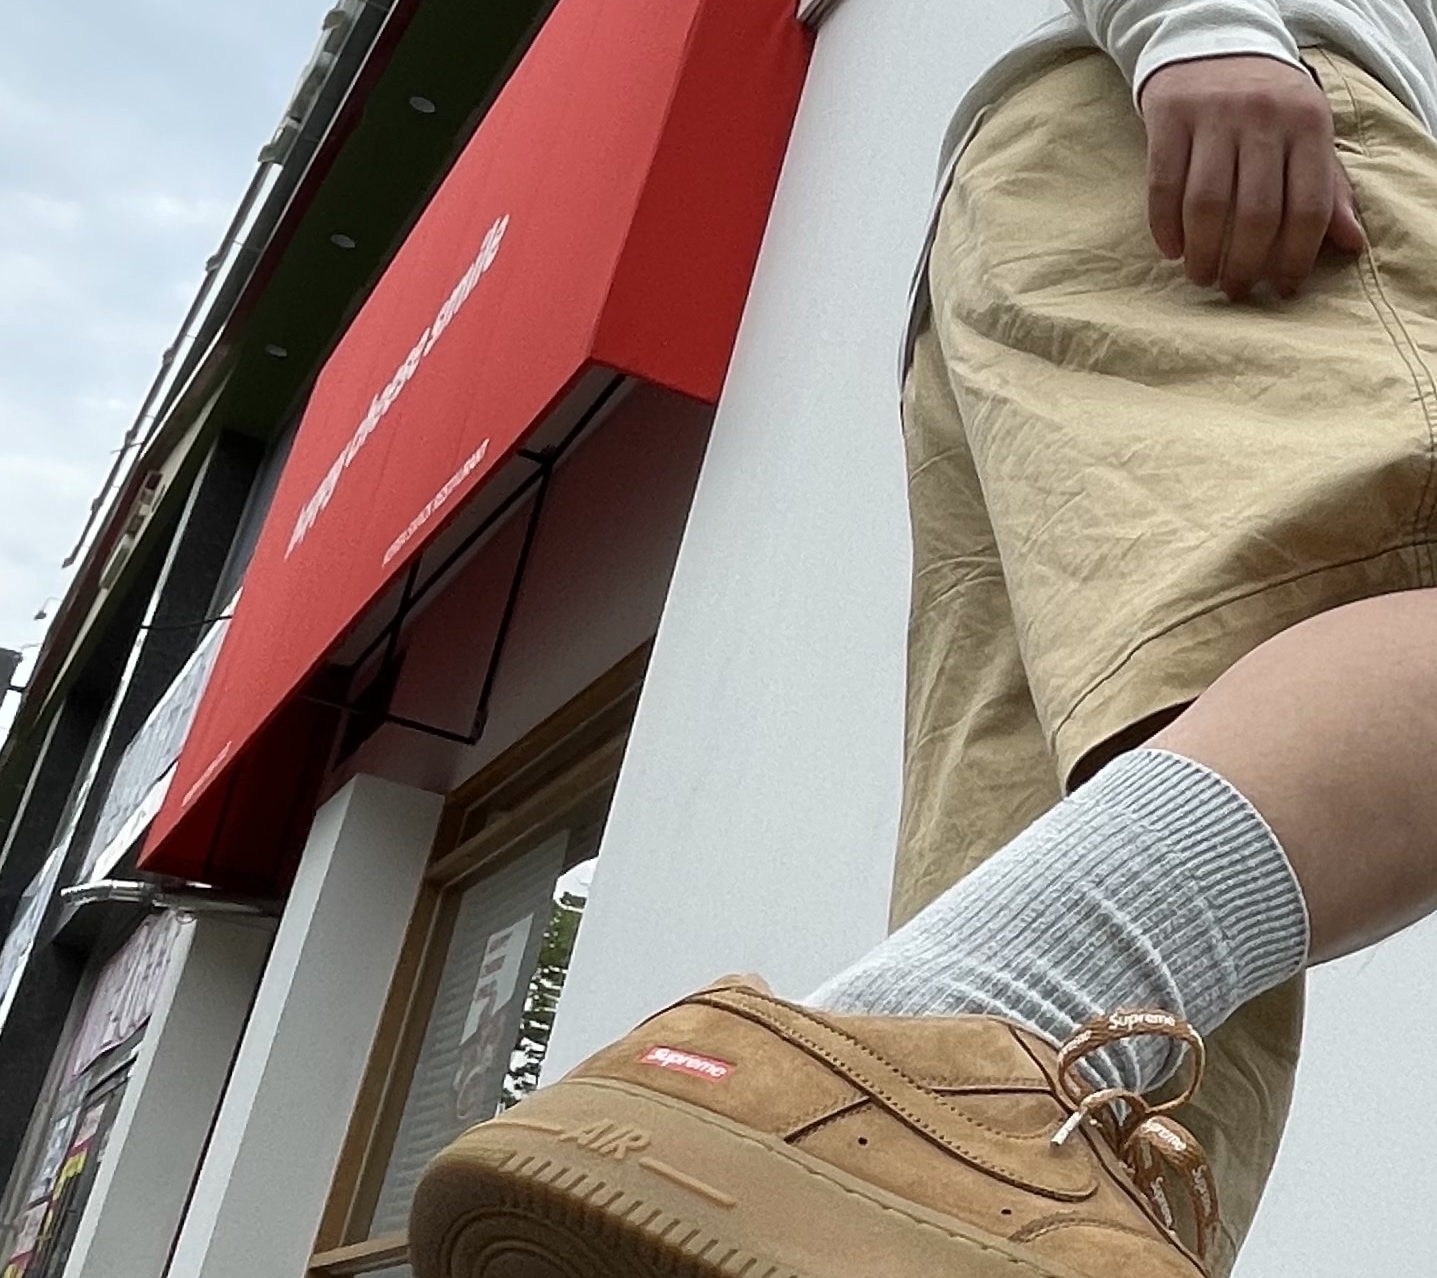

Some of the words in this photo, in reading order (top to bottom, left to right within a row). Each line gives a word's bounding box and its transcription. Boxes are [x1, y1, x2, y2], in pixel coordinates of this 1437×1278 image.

[1108, 1011, 1176, 1031] Supreme
[646, 1047, 727, 1078] Supreme
[560, 1118, 652, 1159] AIR
